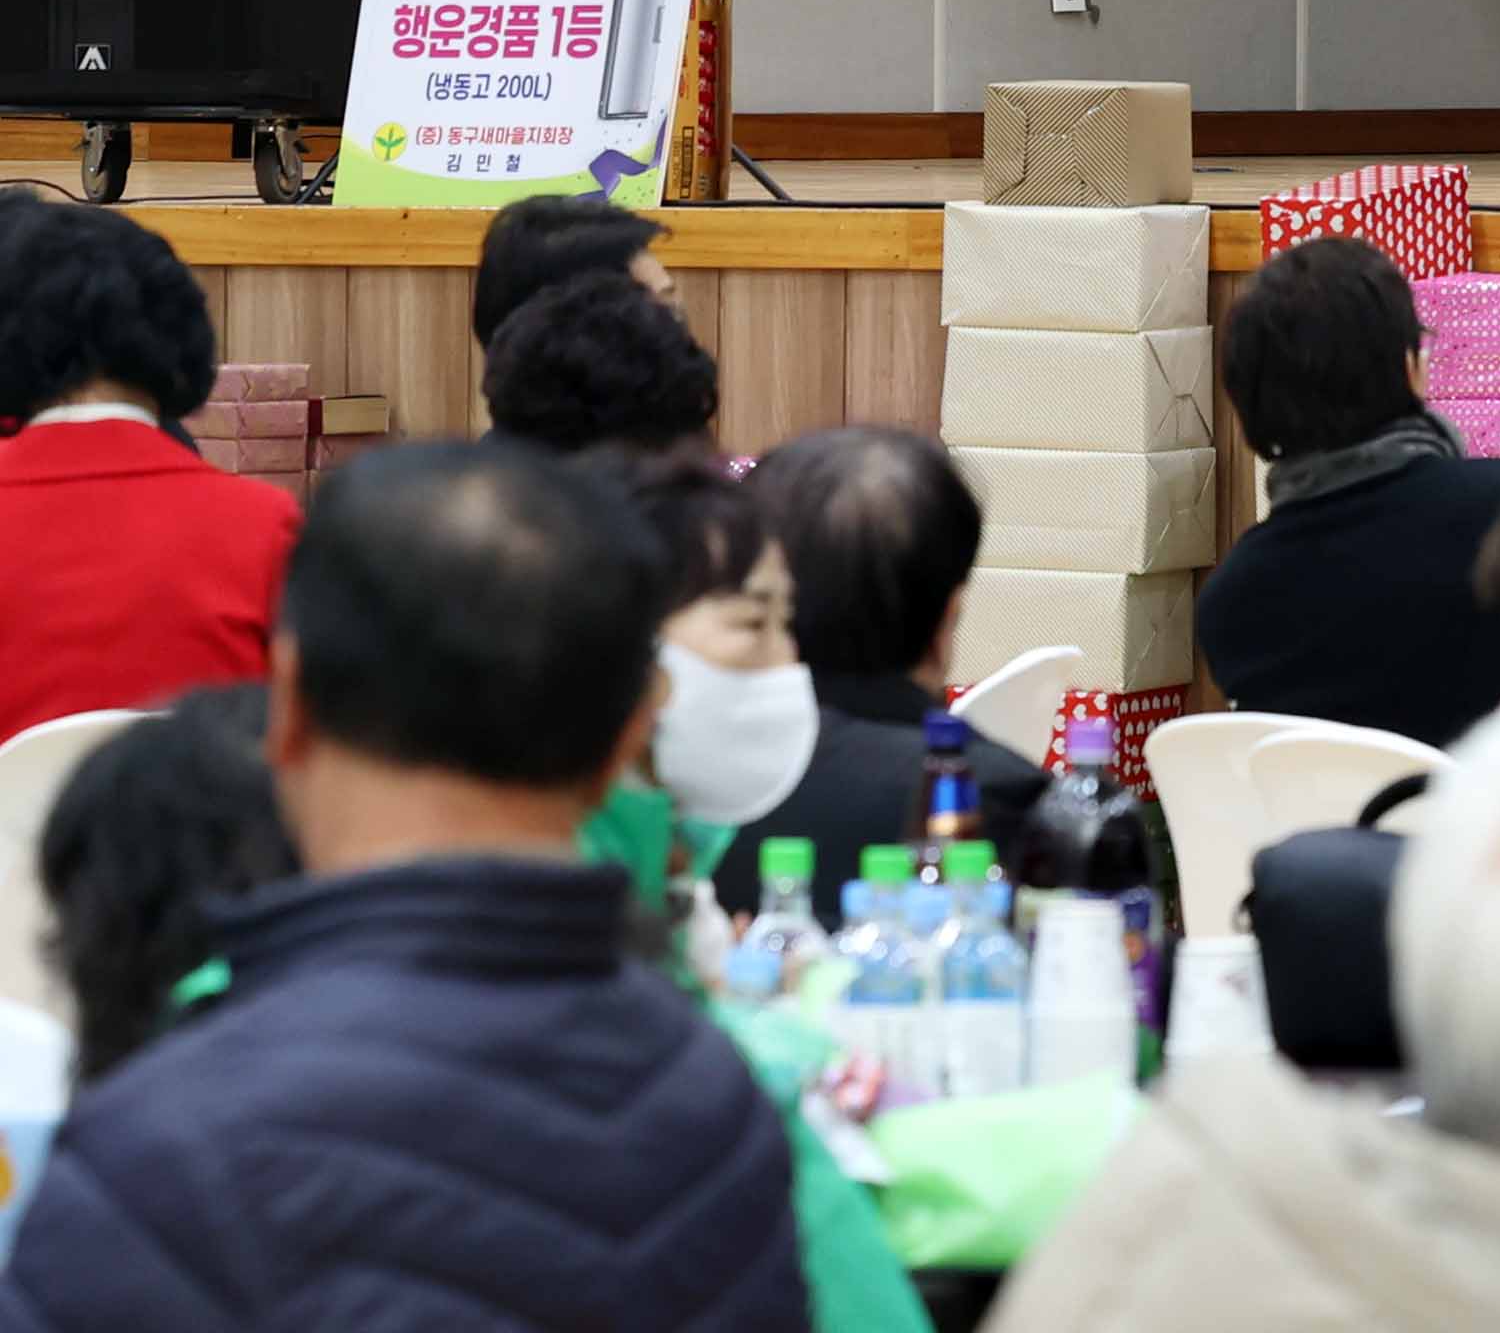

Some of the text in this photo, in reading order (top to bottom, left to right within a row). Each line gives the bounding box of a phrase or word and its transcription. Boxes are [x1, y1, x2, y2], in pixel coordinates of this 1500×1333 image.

[392, 4, 604, 59] 행운경품 1등
[425, 72, 553, 102] (냉동고 200L)
[447, 126, 574, 146] 동구새마을지회장
